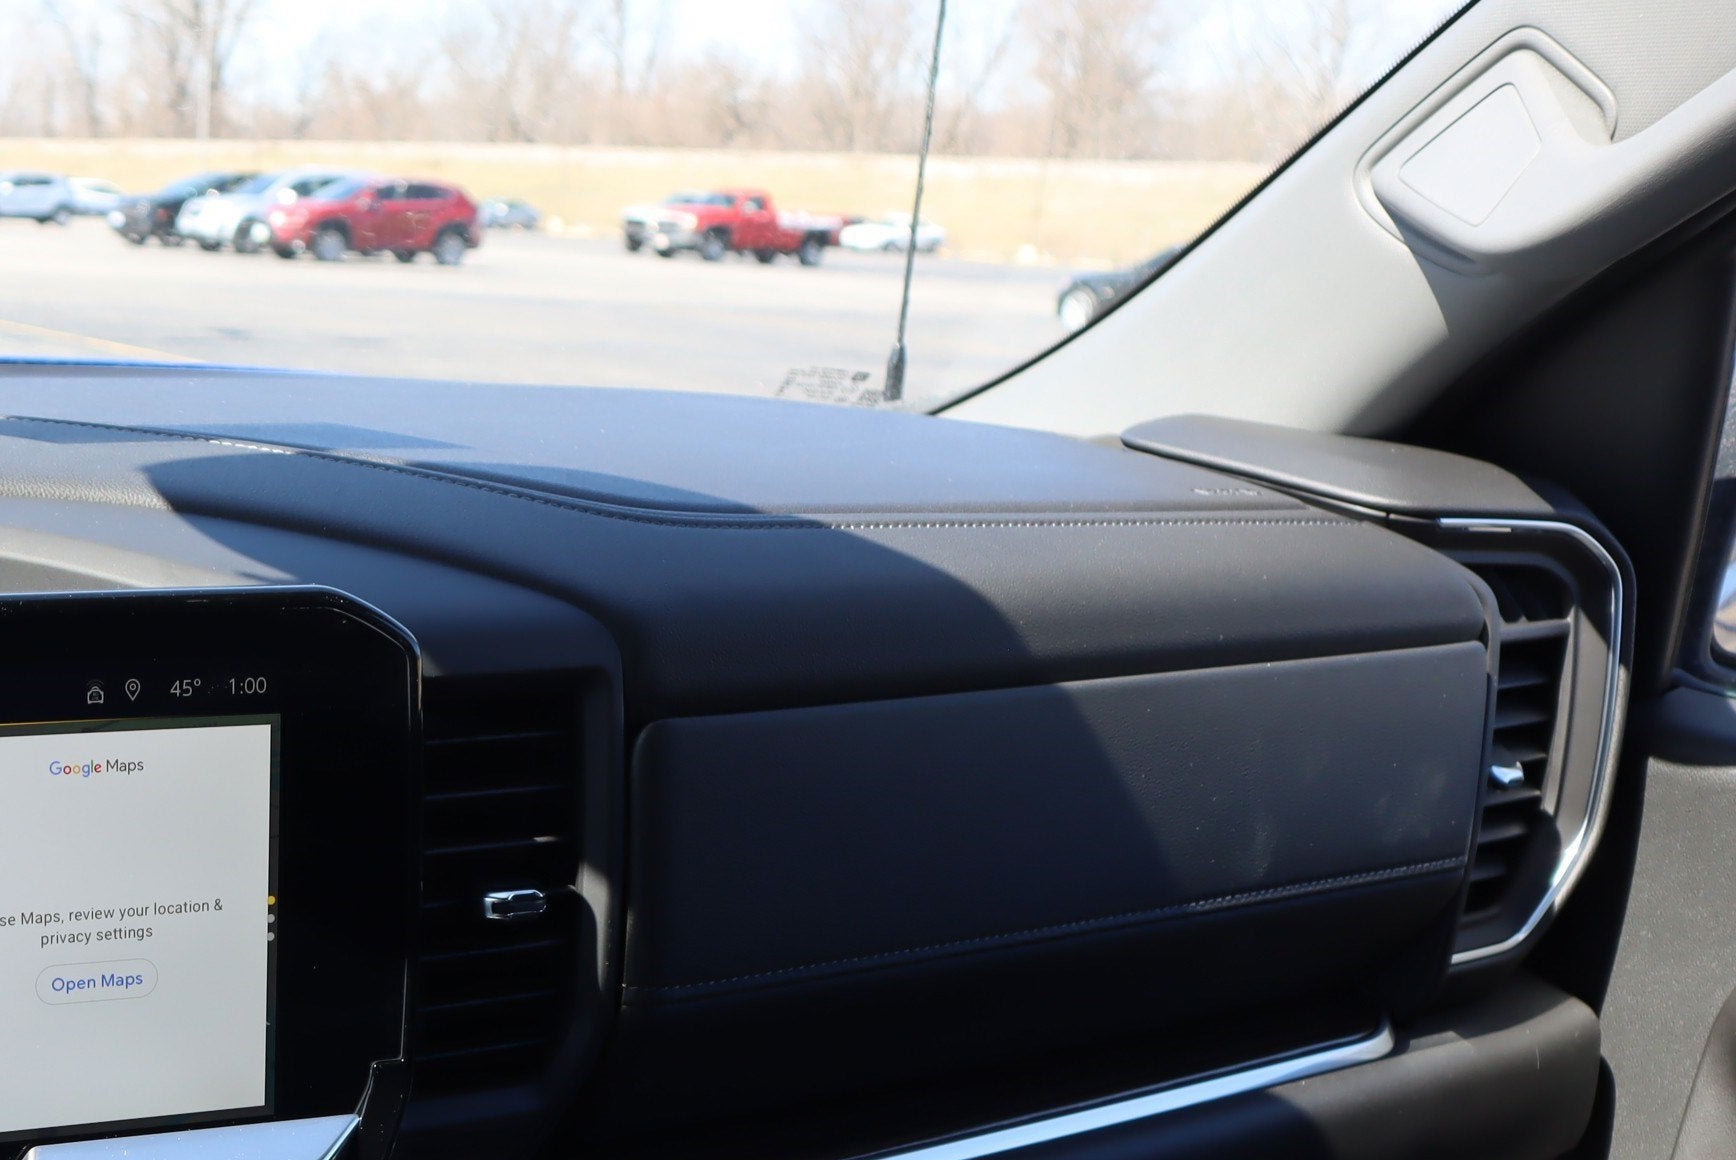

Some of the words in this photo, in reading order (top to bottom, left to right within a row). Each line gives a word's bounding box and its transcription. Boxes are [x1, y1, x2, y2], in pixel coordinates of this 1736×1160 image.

[170, 678, 202, 698] 45°
[229, 677, 267, 695] 1:00
[49, 759, 102, 778] Google
[106, 758, 144, 776] Maps
[20, 910, 64, 927] Maps,
[68, 907, 115, 922] review
[118, 905, 150, 922] your
[153, 901, 210, 916] location
[213, 898, 223, 911] &
[40, 930, 92, 949] privacy
[96, 926, 153, 942] settings
[51, 976, 96, 994] Open
[101, 973, 143, 990] Maps
